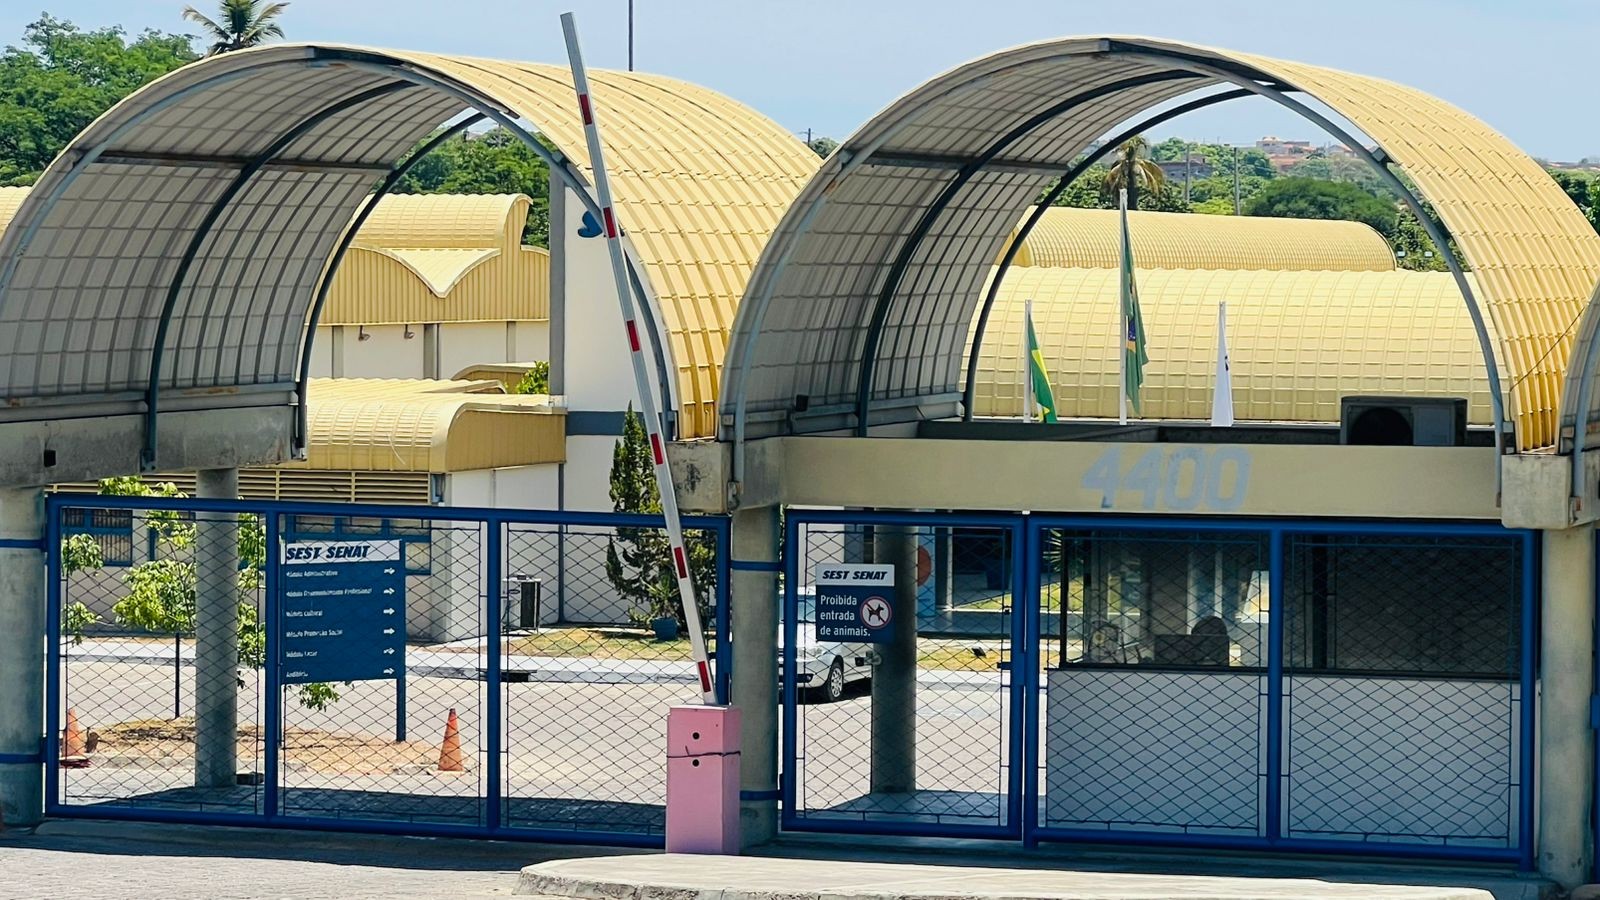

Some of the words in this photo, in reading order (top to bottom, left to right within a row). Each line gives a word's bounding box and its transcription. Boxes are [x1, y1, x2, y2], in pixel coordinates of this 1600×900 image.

[1081, 444, 1252, 511] 4400
[286, 547, 322, 560] SEST
[326, 546, 370, 558] SENAT
[822, 570, 850, 580] SEST
[852, 571, 888, 580] SENAT
[820, 594, 857, 606] Proibida
[820, 610, 855, 621] entrada
[820, 625, 831, 636] de
[833, 625, 871, 637] animais.
